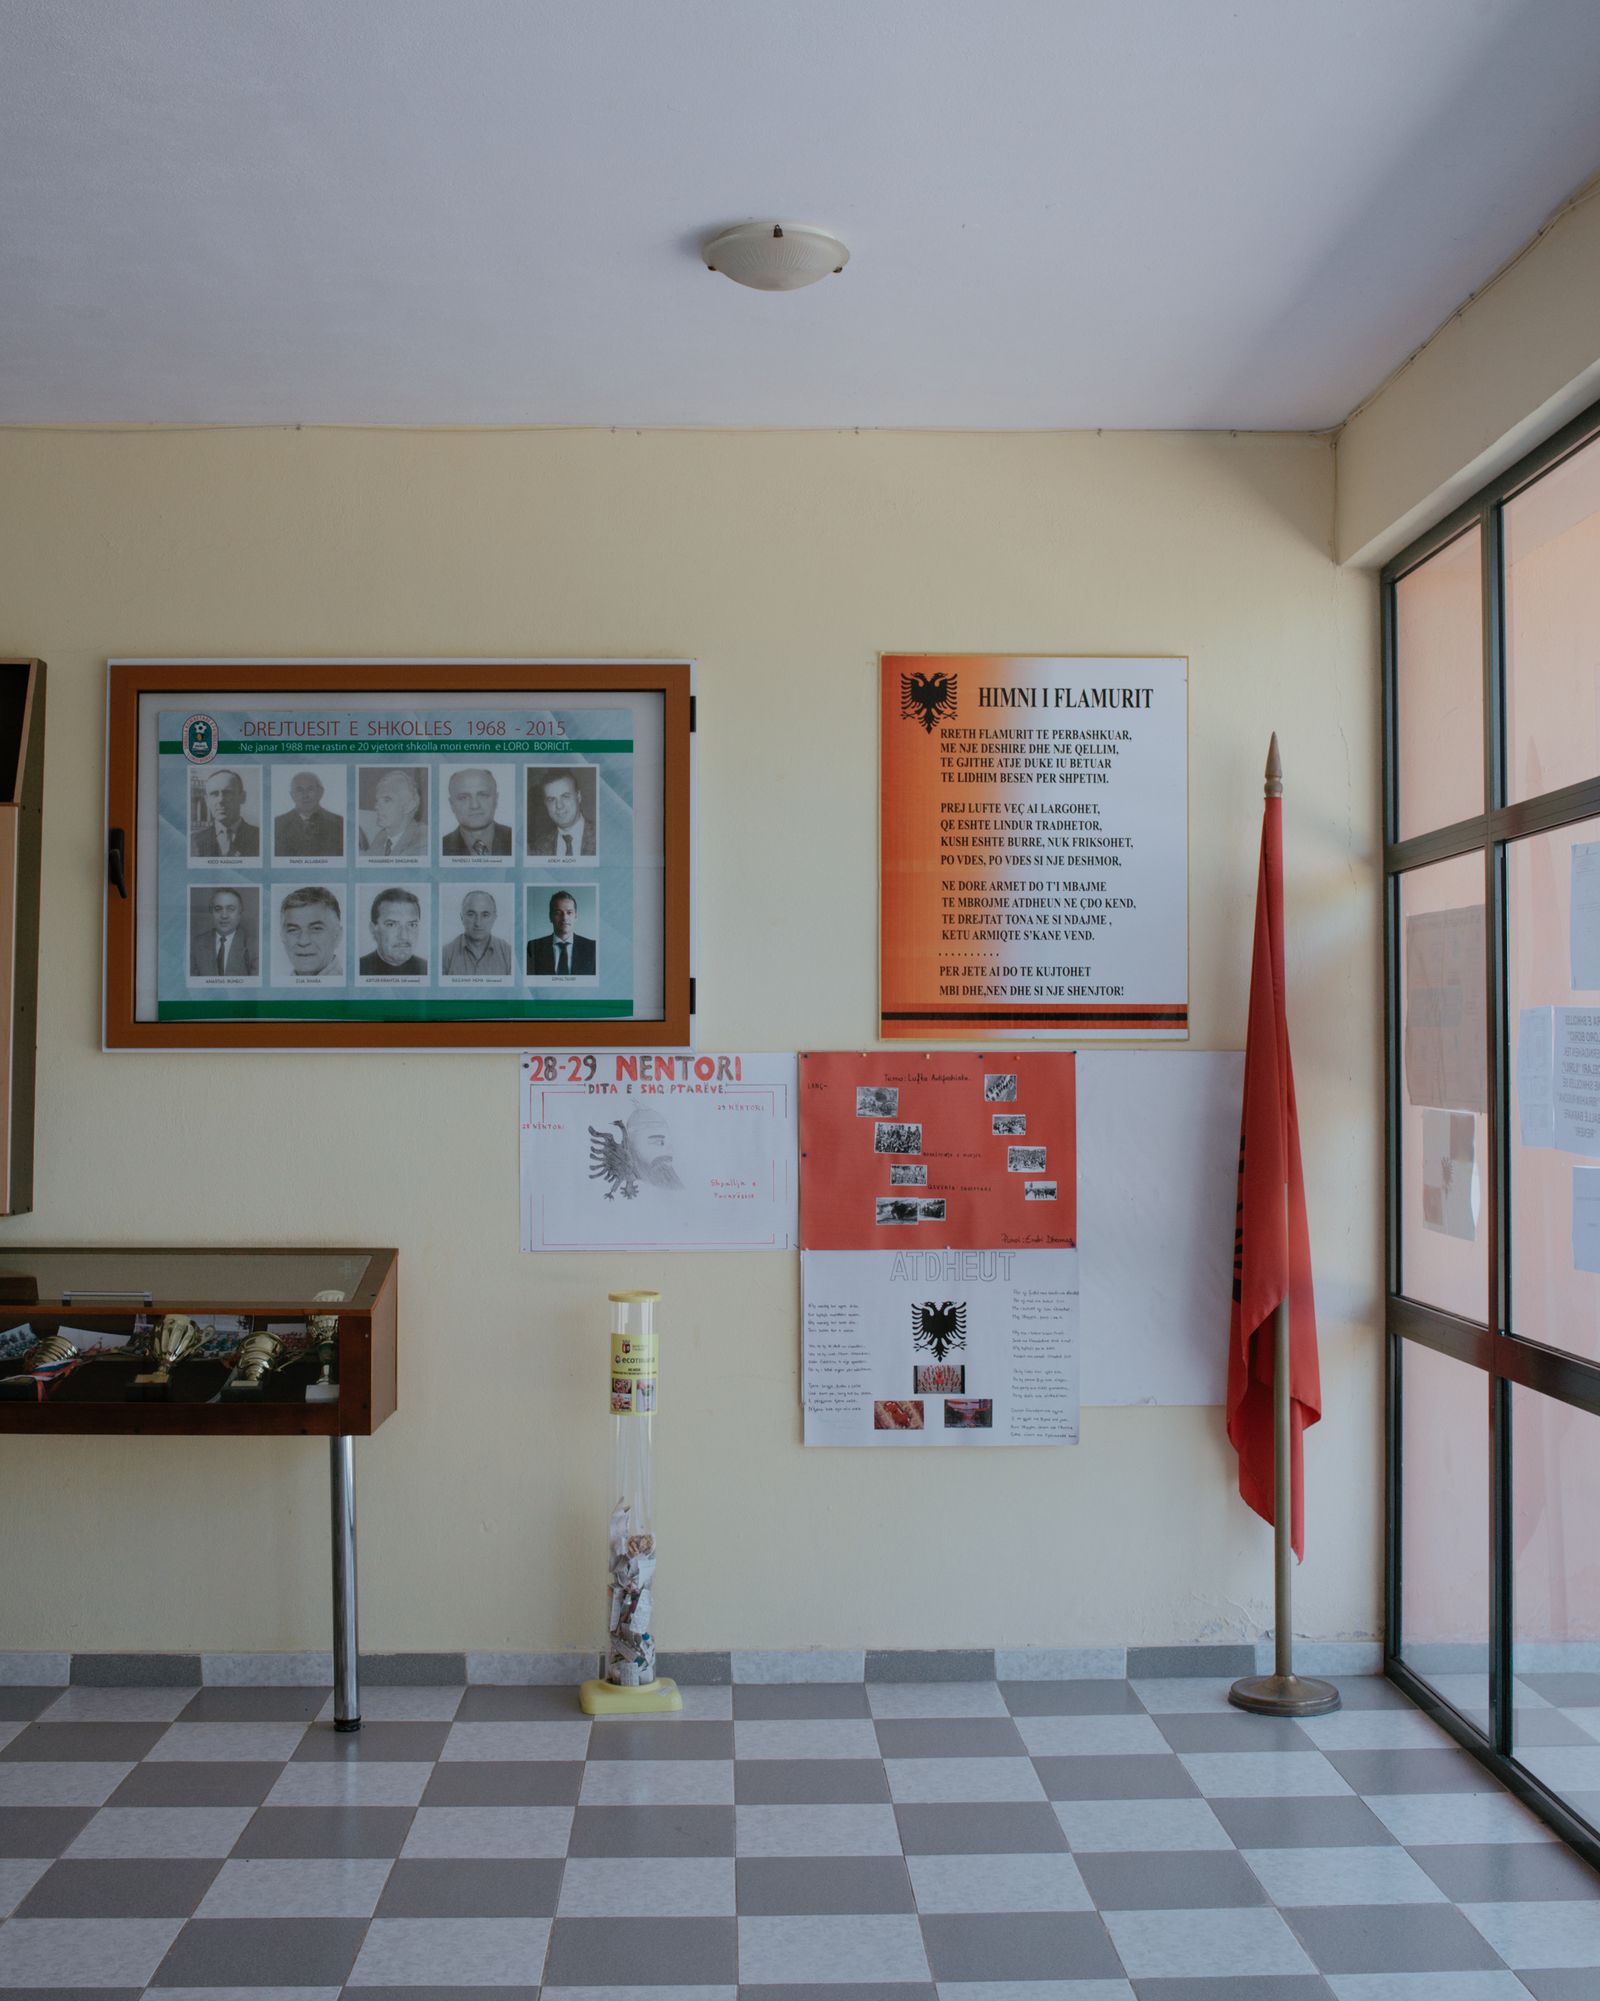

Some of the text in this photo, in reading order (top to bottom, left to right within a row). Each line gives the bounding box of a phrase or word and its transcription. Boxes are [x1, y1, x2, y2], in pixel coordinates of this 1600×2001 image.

[979, 687, 1154, 709] HIMNI I FLAMURIT
[243, 720, 341, 737] DREJTUESIT
[349, 720, 359, 737] E
[367, 720, 453, 737] SHKOLLES
[467, 720, 506, 737] 1968
[526, 719, 566, 736] 2015
[940, 728, 1133, 741] RRETH FLAMURIT TE PERBASHKUAR,
[240, 743, 253, 751] Ne
[255, 743, 278, 753] janar
[281, 743, 303, 752] 1988
[322, 743, 347, 752] rastin
[358, 743, 370, 751] 20
[371, 742, 404, 753] vjetorit
[406, 742, 438, 751] shkolla
[440, 742, 462, 751] mori
[464, 742, 490, 751] emrin
[503, 742, 530, 752] LORO
[940, 742, 1119, 757] ME NJE DESHIRE DHE NJE QELLIM,
[940, 757, 1112, 769] TE GJITHE ATJE DUKE IU BETUAR
[940, 772, 1109, 784] TE LIDHIM BESEN PER SHPETIM.
[940, 802, 1101, 816] PREJ LUFTE VEÇ AI LARGOHET,
[940, 819, 1103, 832] QE ESHTE LINDUR TRADHETOR,
[940, 836, 1134, 849] KUSH ESHTE BURRE, NUK FRIKSOHET,
[940, 854, 1122, 867] PO VDES, PO VDES SI NJE DESHMOR,
[941, 880, 1107, 892] NE DORE ARMET DO T'I MBAJME
[942, 897, 1137, 910] TE MBROJME ATDHEUN NE ÇDO KEND,
[943, 913, 956, 925] TE
[957, 913, 1004, 925] DREJTAT
[1004, 914, 1034, 925] TONA
[1035, 914, 1050, 925] NE
[1051, 914, 1062, 925] SI
[1064, 914, 1107, 926] NDAJME
[942, 929, 1095, 943] KETU ARMIQTE S'KANE VEND.
[939, 965, 1091, 977] PER JETE AI DO TE KUJTOHET
[939, 985, 1124, 997] MBI DHE,NEN DHE SI NJE SHENJTOR!
[530, 1054, 742, 1082] 28-29 NENTORI
[588, 1083, 618, 1095] DITA
[626, 1083, 633, 1094] E
[889, 1251, 1016, 1283] ATDHEUT
